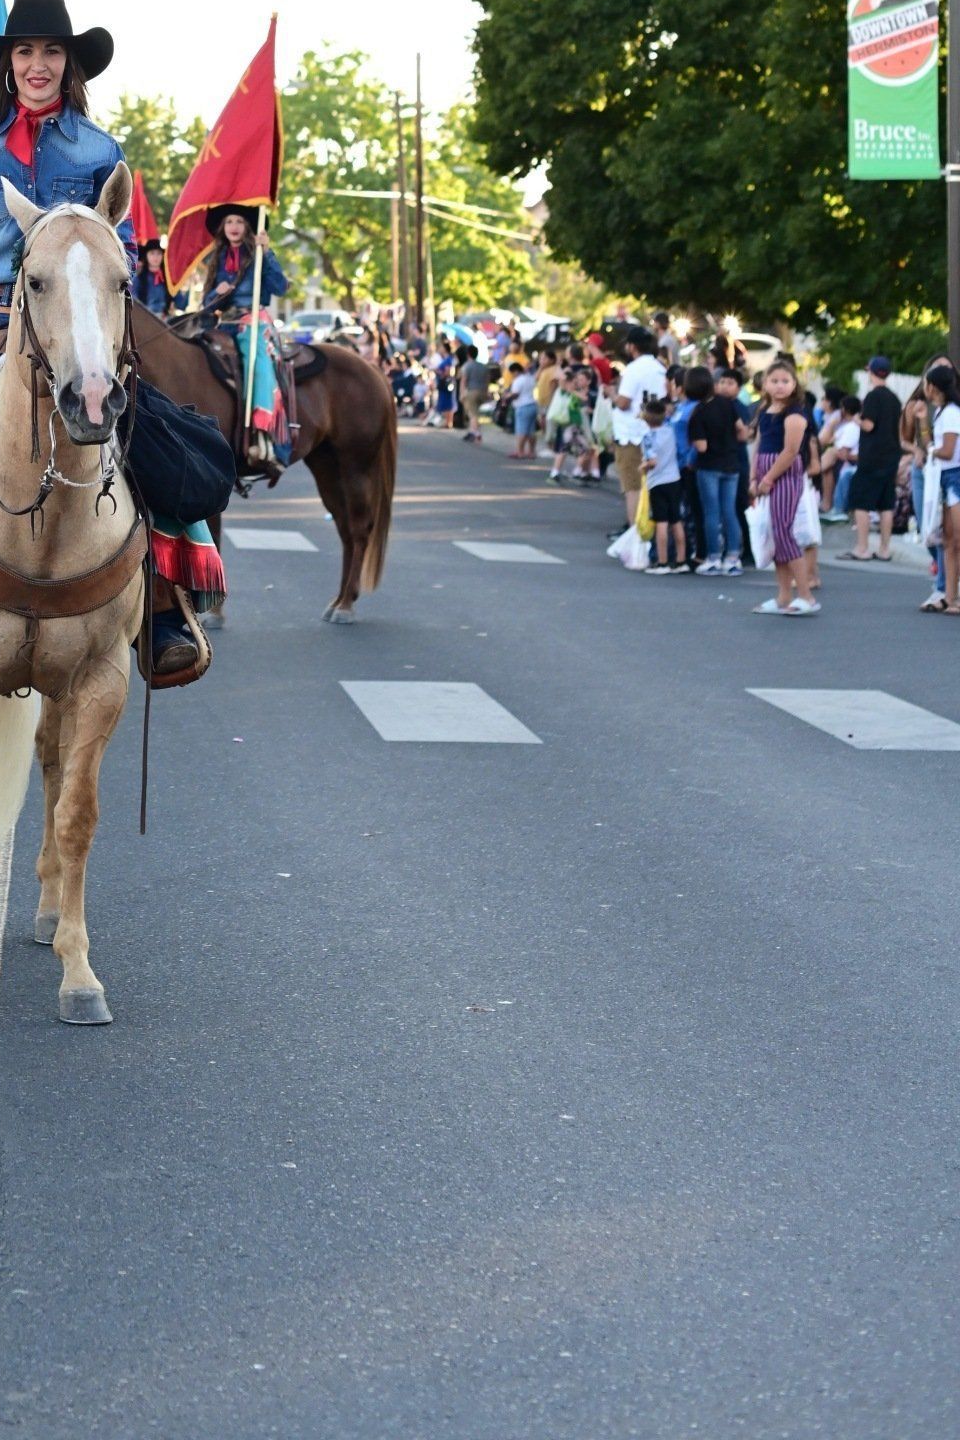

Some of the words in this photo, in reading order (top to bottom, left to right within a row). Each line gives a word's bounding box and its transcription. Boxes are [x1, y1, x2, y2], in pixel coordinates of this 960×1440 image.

[851, 4, 929, 45] DOWNTOWN
[856, 23, 936, 60] HERMISTON
[854, 119, 916, 141] Bruce
